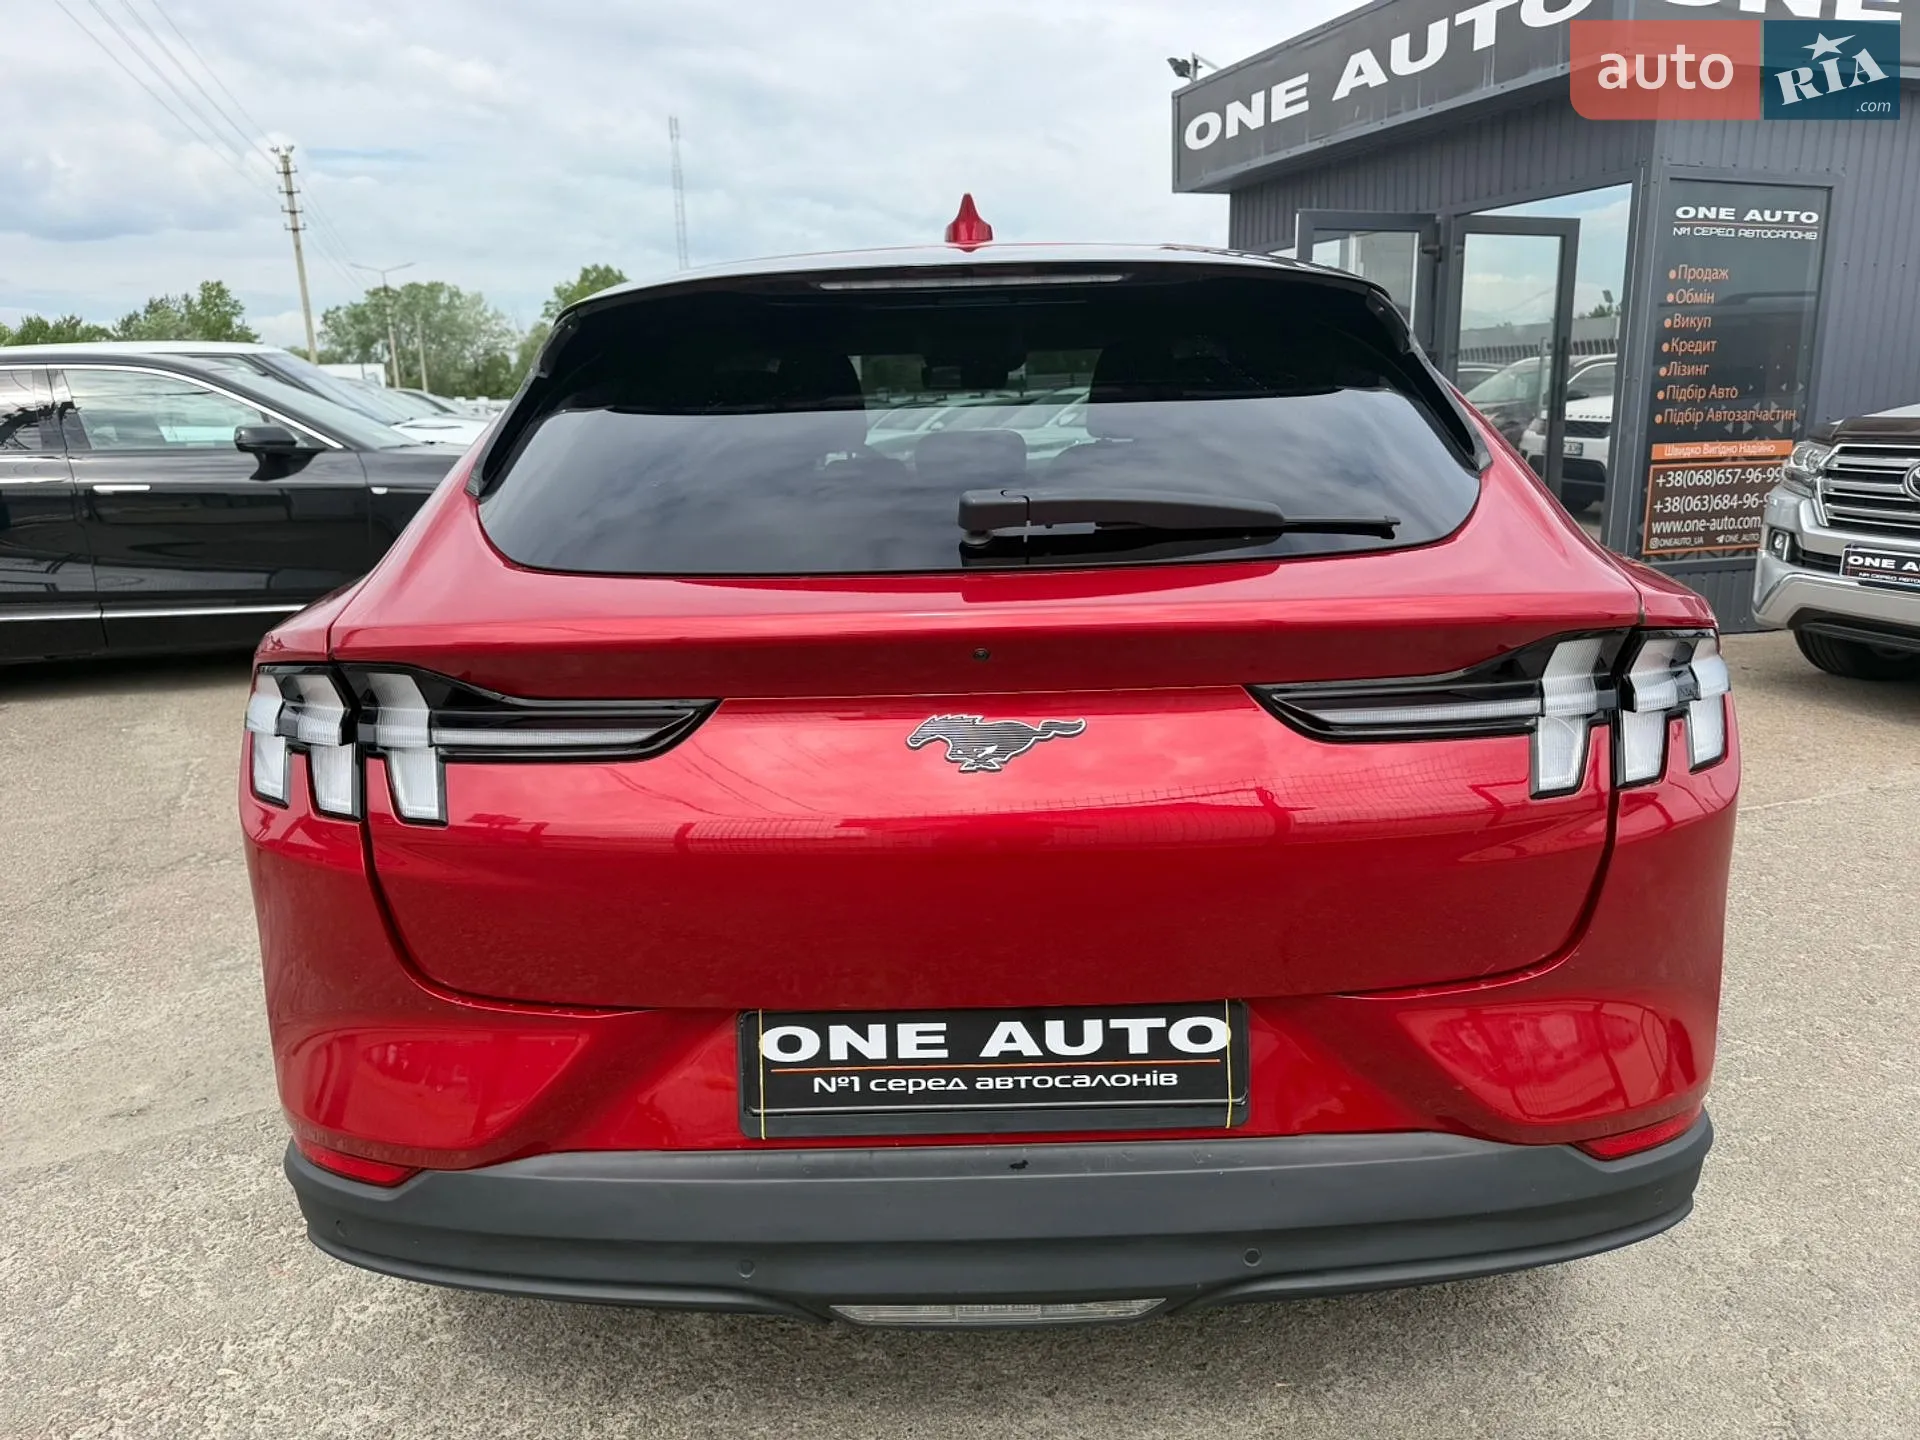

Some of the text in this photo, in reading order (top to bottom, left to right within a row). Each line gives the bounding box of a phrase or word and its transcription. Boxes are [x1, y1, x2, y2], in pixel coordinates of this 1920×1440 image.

[1184, 73, 1310, 150] ONE
[1675, 206, 1819, 224] ONE AUTO
[1678, 264, 1729, 283] Продаж
[1675, 288, 1715, 305] Обмін
[1673, 313, 1712, 332] Викуп
[1671, 337, 1718, 356] Кредит
[1667, 361, 1710, 377] Лізинг
[1666, 384, 1739, 402] Підбір Авто
[1664, 407, 1797, 425] Підбір Автозапчастин
[1654, 493, 1770, 513] +38(063)684-96-9
[1847, 555, 1920, 572] ONE A
[761, 1016, 1230, 1063] ONE AUTO
[813, 1071, 1178, 1096] №1 серед автосалонів
